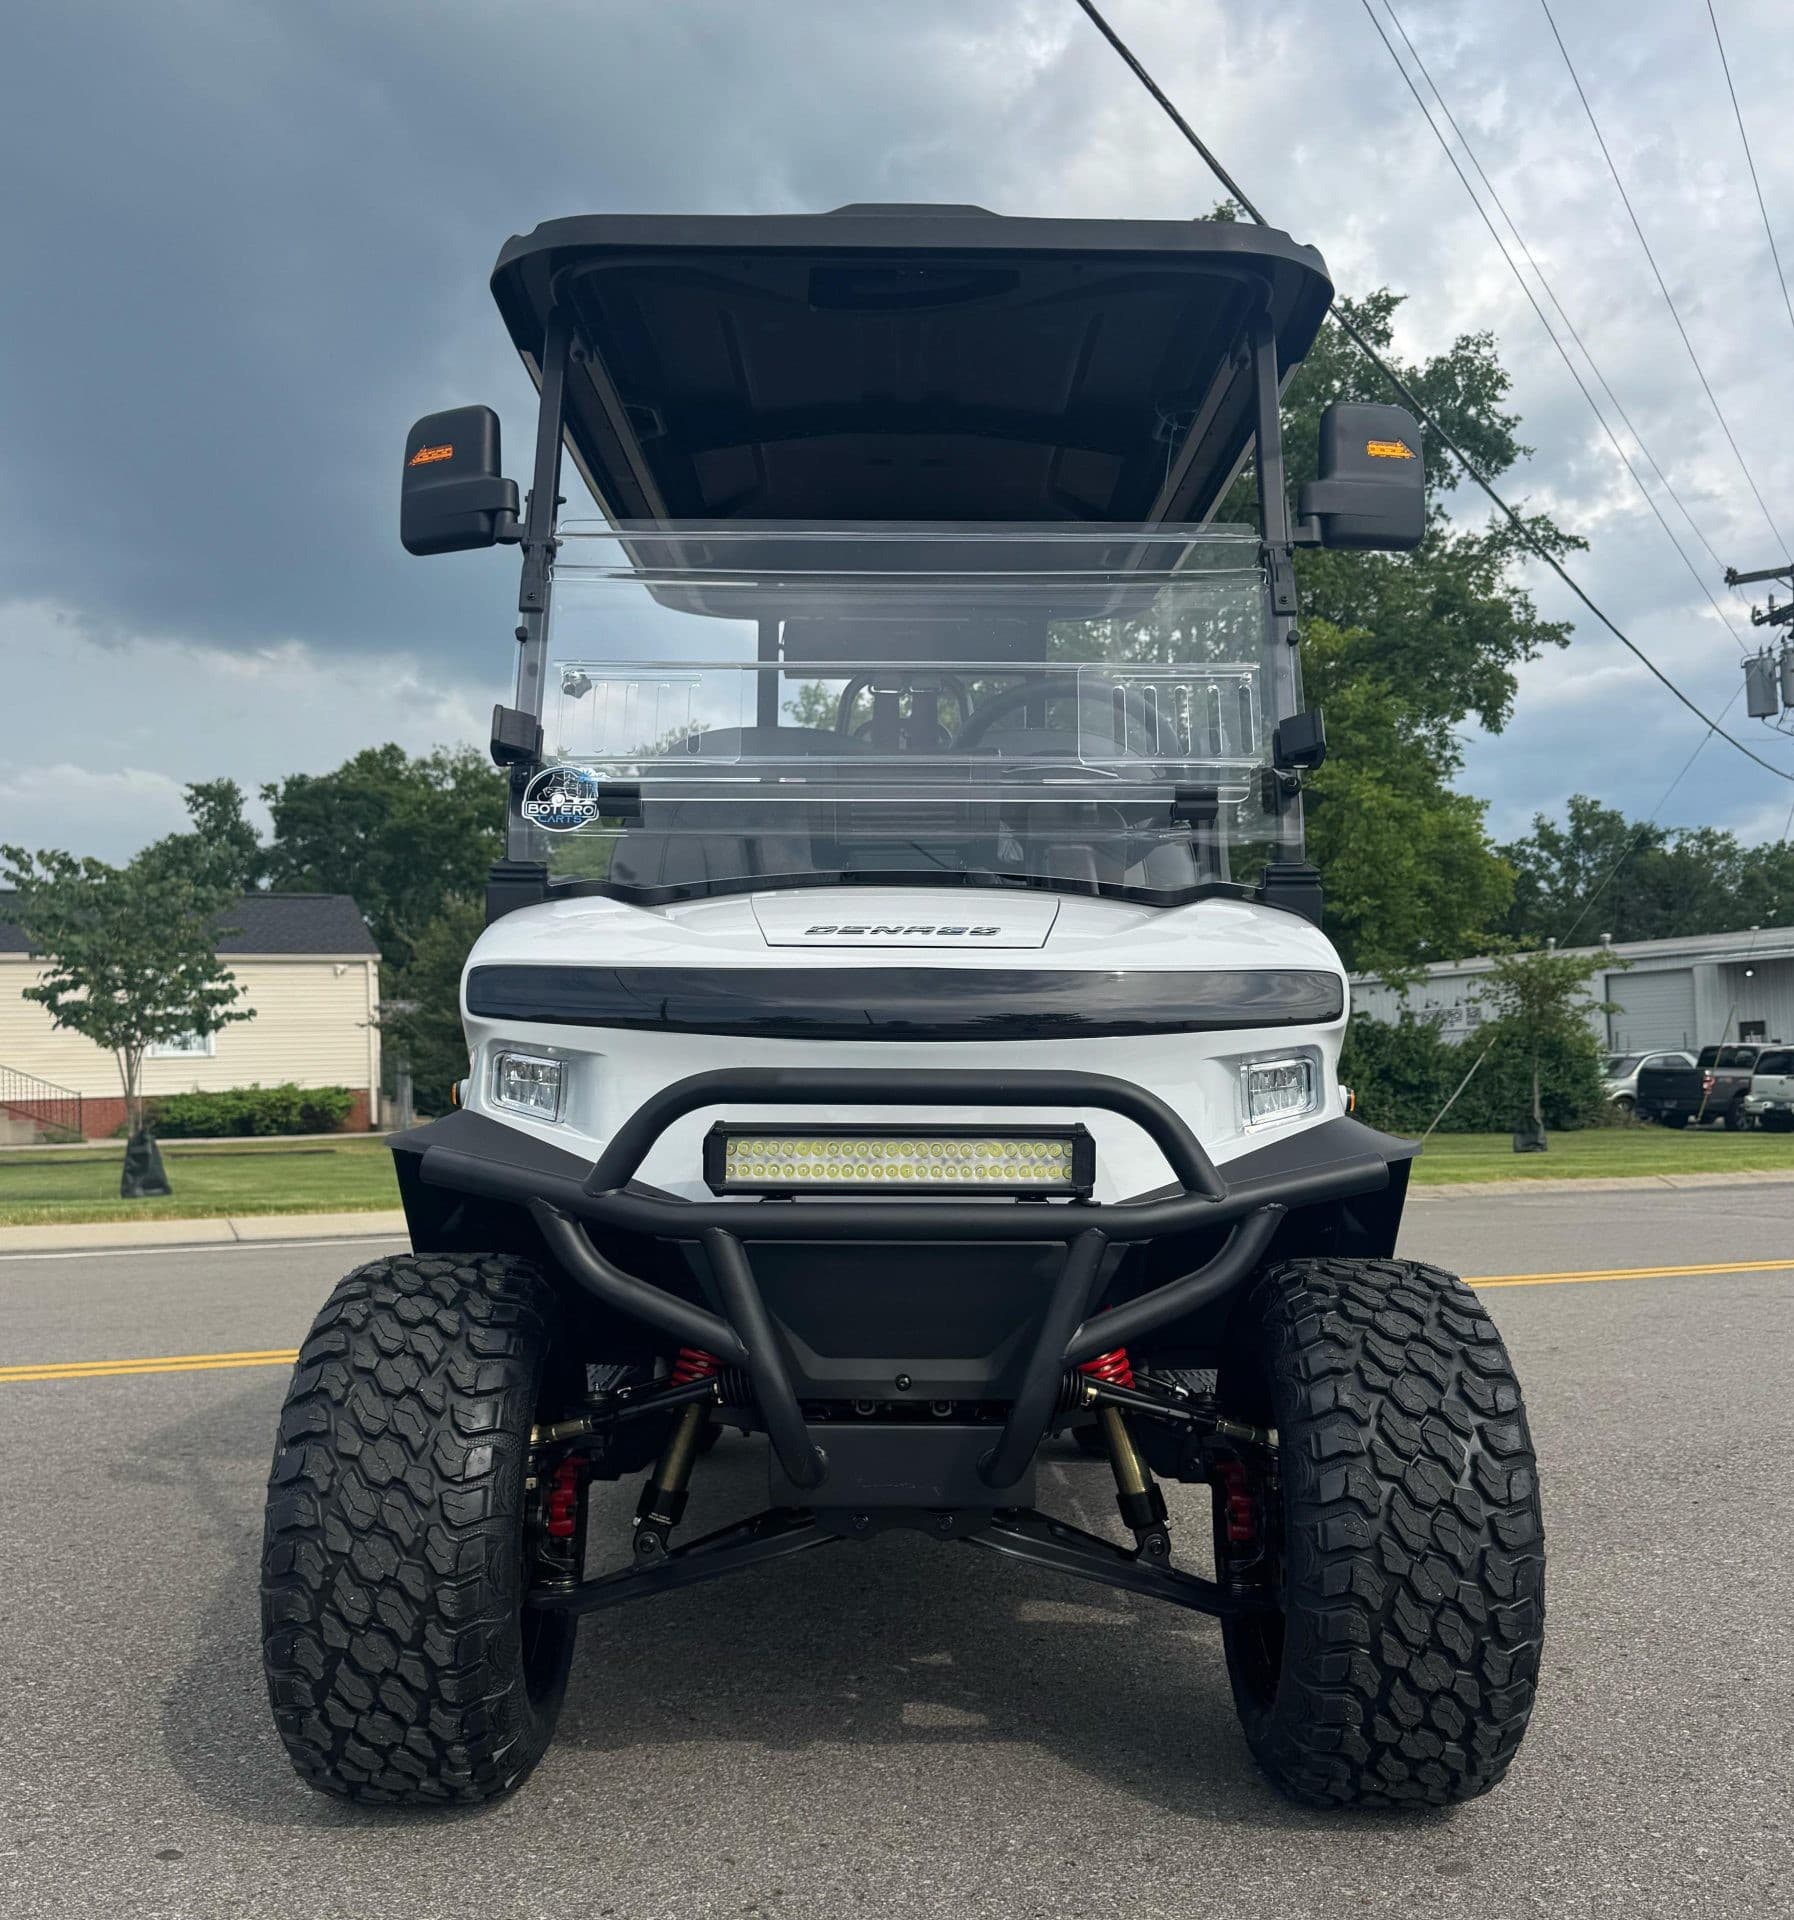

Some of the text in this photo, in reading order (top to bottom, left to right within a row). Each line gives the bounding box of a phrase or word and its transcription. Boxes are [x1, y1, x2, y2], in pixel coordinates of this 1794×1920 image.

[528, 804, 594, 816] BOTERO
[538, 815, 582, 823] CARTS
[804, 925, 1001, 936] DENAGO
